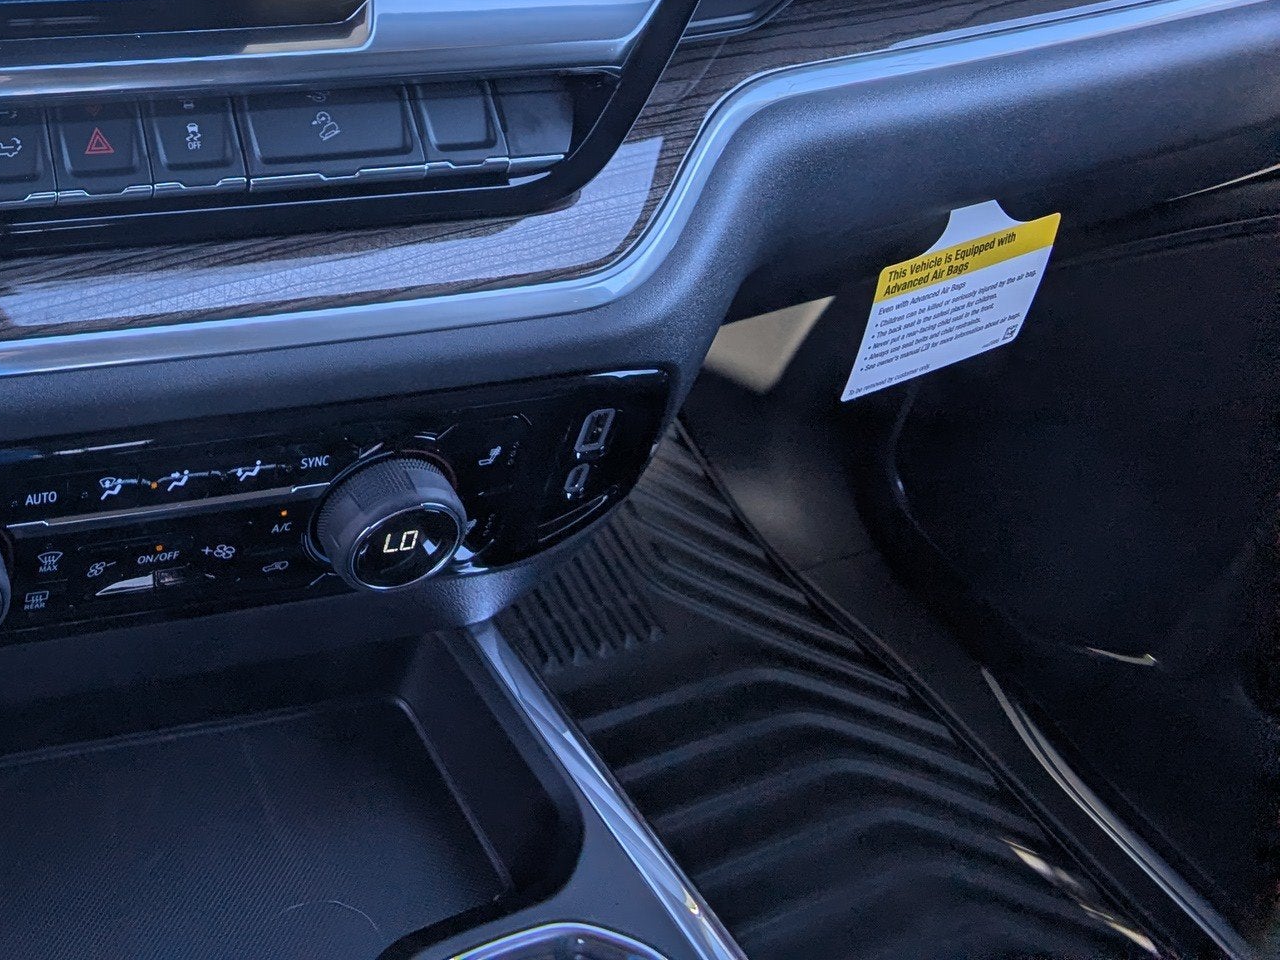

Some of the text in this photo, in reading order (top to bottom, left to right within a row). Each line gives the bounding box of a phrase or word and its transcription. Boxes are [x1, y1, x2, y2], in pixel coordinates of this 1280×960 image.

[187, 141, 201, 150] OFF
[889, 233, 1016, 282] This Vehicle is Equipped with
[884, 262, 969, 296] Advanced Air Bags
[300, 454, 330, 470] SYNC
[25, 490, 58, 506] AUTO
[271, 521, 291, 533] A/C
[136, 550, 181, 565] ON/OFF
[38, 563, 58, 573] MAX
[23, 601, 46, 611] REAR
